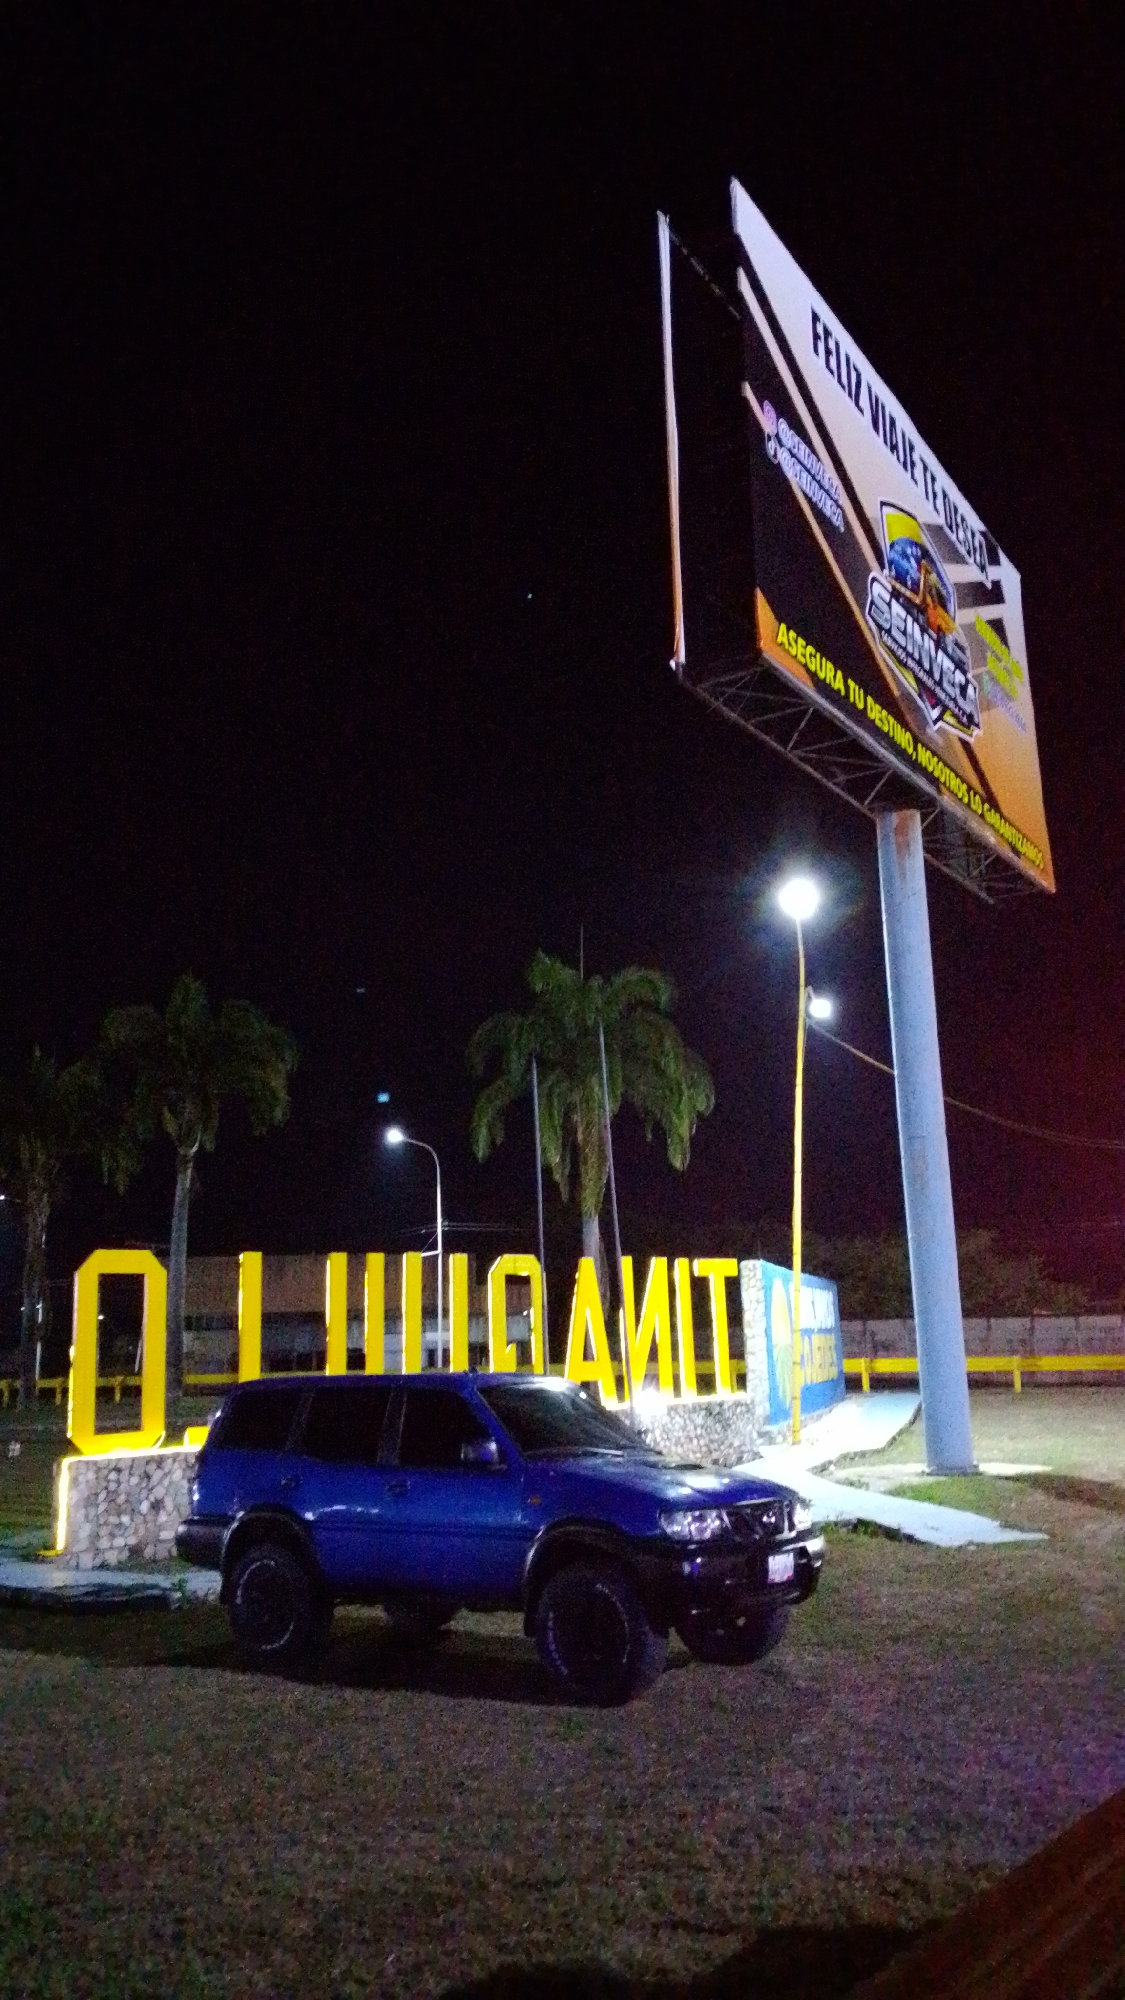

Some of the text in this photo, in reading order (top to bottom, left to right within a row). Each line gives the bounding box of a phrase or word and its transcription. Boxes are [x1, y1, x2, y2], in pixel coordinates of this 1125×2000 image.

[811, 304, 991, 586] FELIZ VIAJE TE DESEA
[777, 623, 845, 696] ASEGURA
[848, 678, 865, 710] TU
[867, 695, 916, 760] DESTINO,
[918, 743, 968, 804] NOSOTROS
[970, 791, 982, 815] LO
[871, 580, 979, 725] SEINVECA
